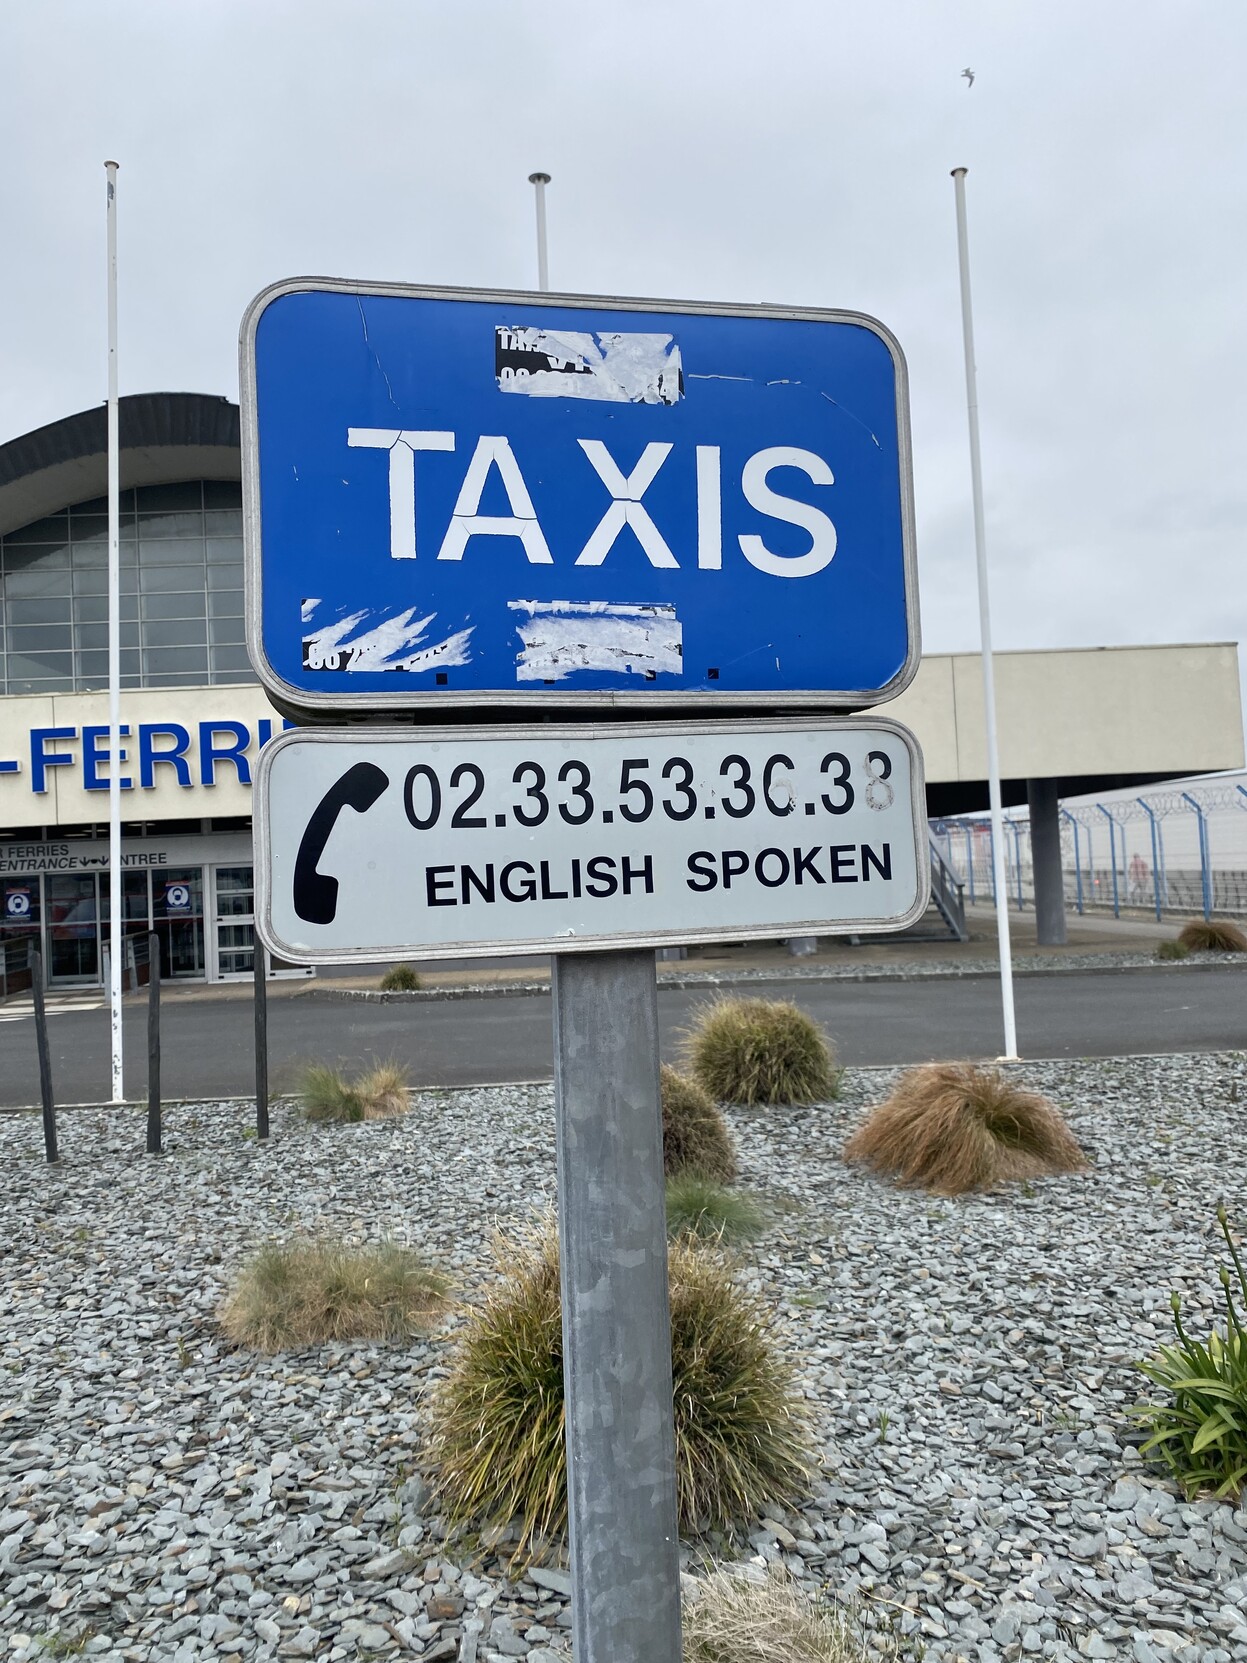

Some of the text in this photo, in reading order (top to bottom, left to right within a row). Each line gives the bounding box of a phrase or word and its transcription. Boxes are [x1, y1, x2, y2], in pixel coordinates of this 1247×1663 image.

[347, 427, 838, 578] TAXIS
[403, 751, 894, 830] 02.33.53.36.38
[0, 852, 167, 871] ENTRANCE NTREE
[8, 844, 69, 858] FERRIES
[425, 842, 893, 906] ENGLISH SPOKEN
